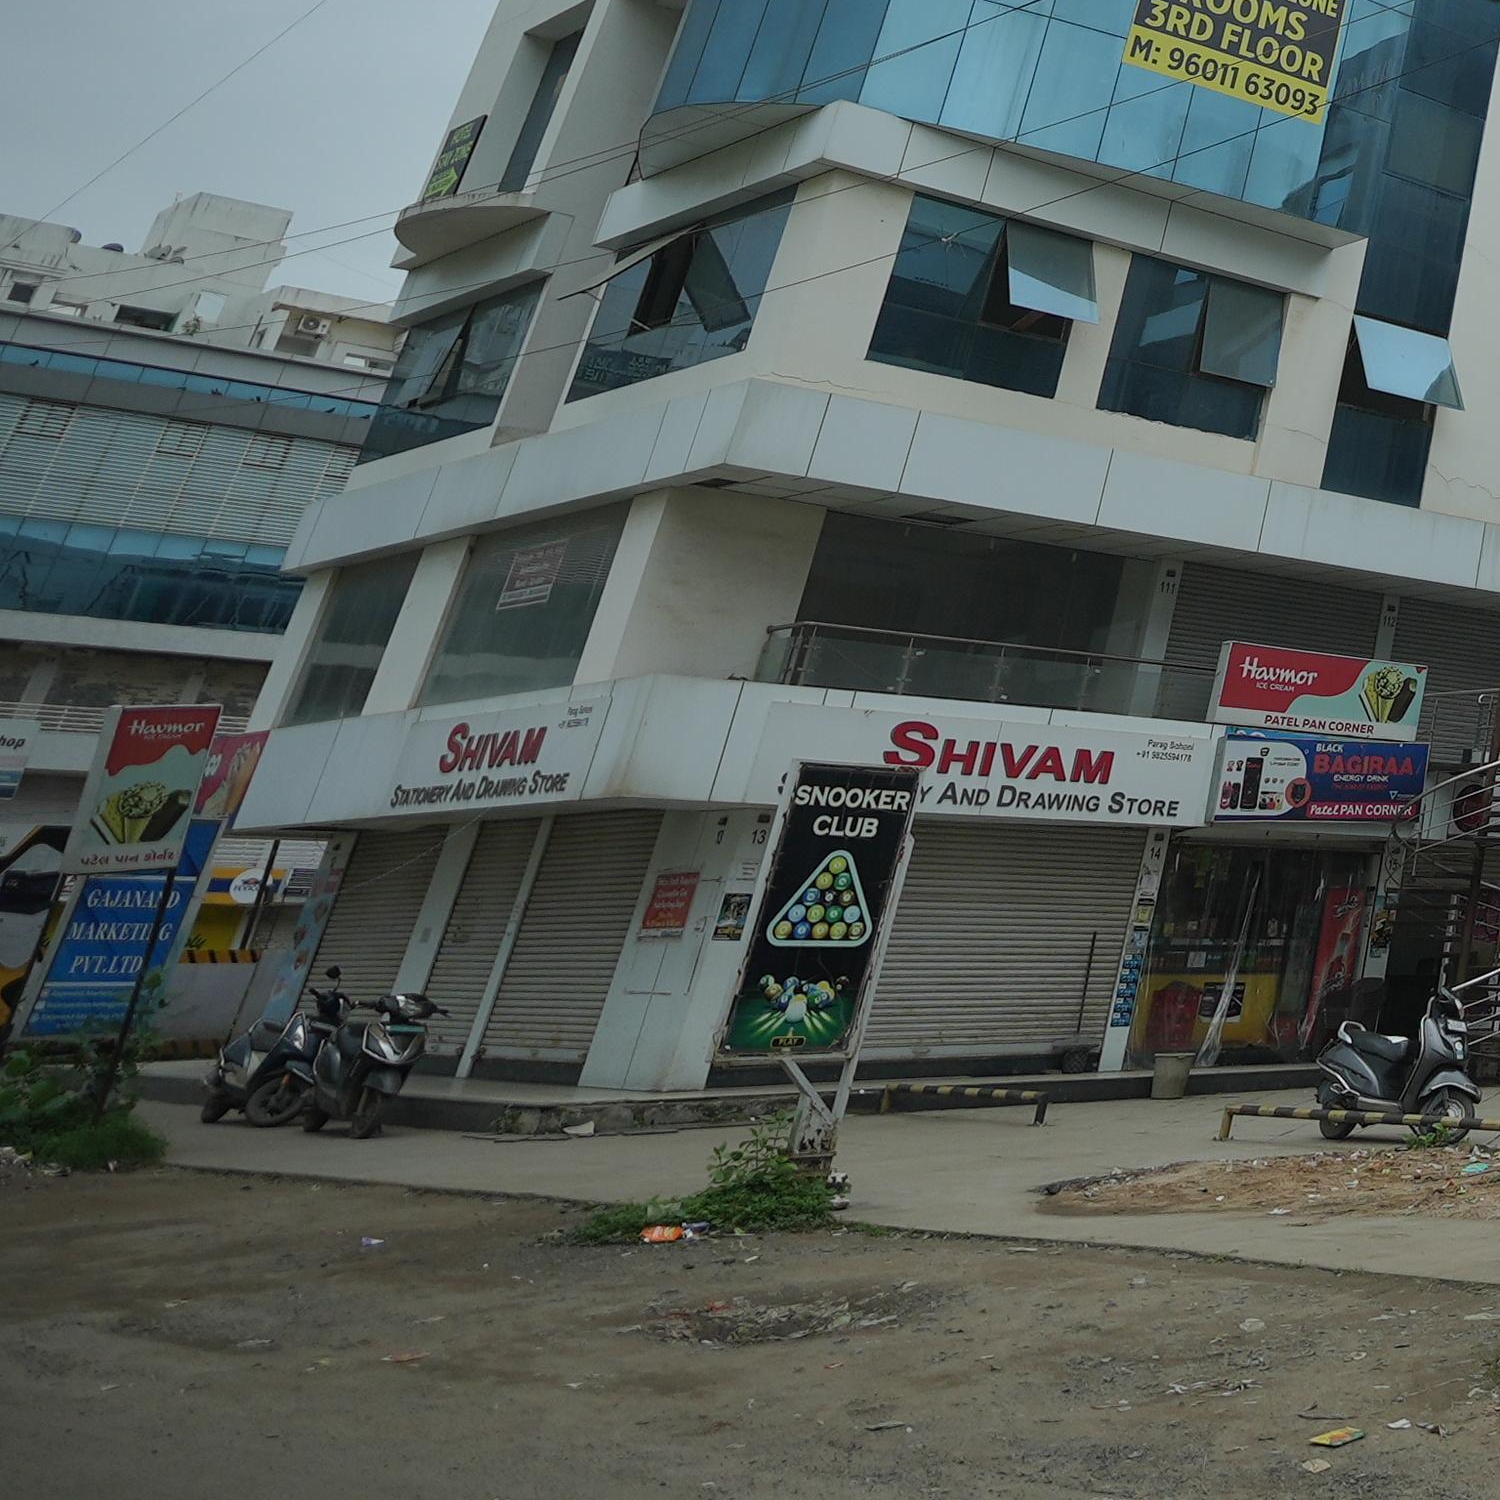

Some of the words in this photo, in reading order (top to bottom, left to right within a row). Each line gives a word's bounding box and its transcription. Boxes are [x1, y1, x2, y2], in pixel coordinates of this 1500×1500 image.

[1220, 25, 1325, 82] FLOOR
[1130, 35, 1161, 64] M:
[1168, 47, 1240, 89] 96011
[1244, 73, 1320, 116] 63093
[1240, 655, 1319, 686] Havmor
[128, 719, 205, 735] Havmor
[1264, 715, 1300, 728] PATEL
[1303, 718, 1326, 731] PAN
[1328, 721, 1374, 734] CORNER
[439, 722, 548, 773] SHIVAM
[882, 720, 1115, 785] SHIVAM
[1316, 743, 1344, 753] BLACK
[1313, 754, 1414, 776] BAGIRAA
[390, 785, 451, 807] STATIONERY
[450, 779, 474, 800] AND
[476, 776, 528, 799] DRAWING
[528, 771, 570, 794] STORE
[794, 784, 912, 812] SNOOKER
[938, 782, 989, 807] AND
[998, 785, 1099, 812] DRAWING
[1108, 791, 1180, 817] STORE
[1310, 803, 1340, 816] Patel
[1340, 803, 1364, 815] PAN
[751, 829, 767, 845] 13
[812, 815, 879, 838] CLUB
[1150, 846, 1161, 860] 14
